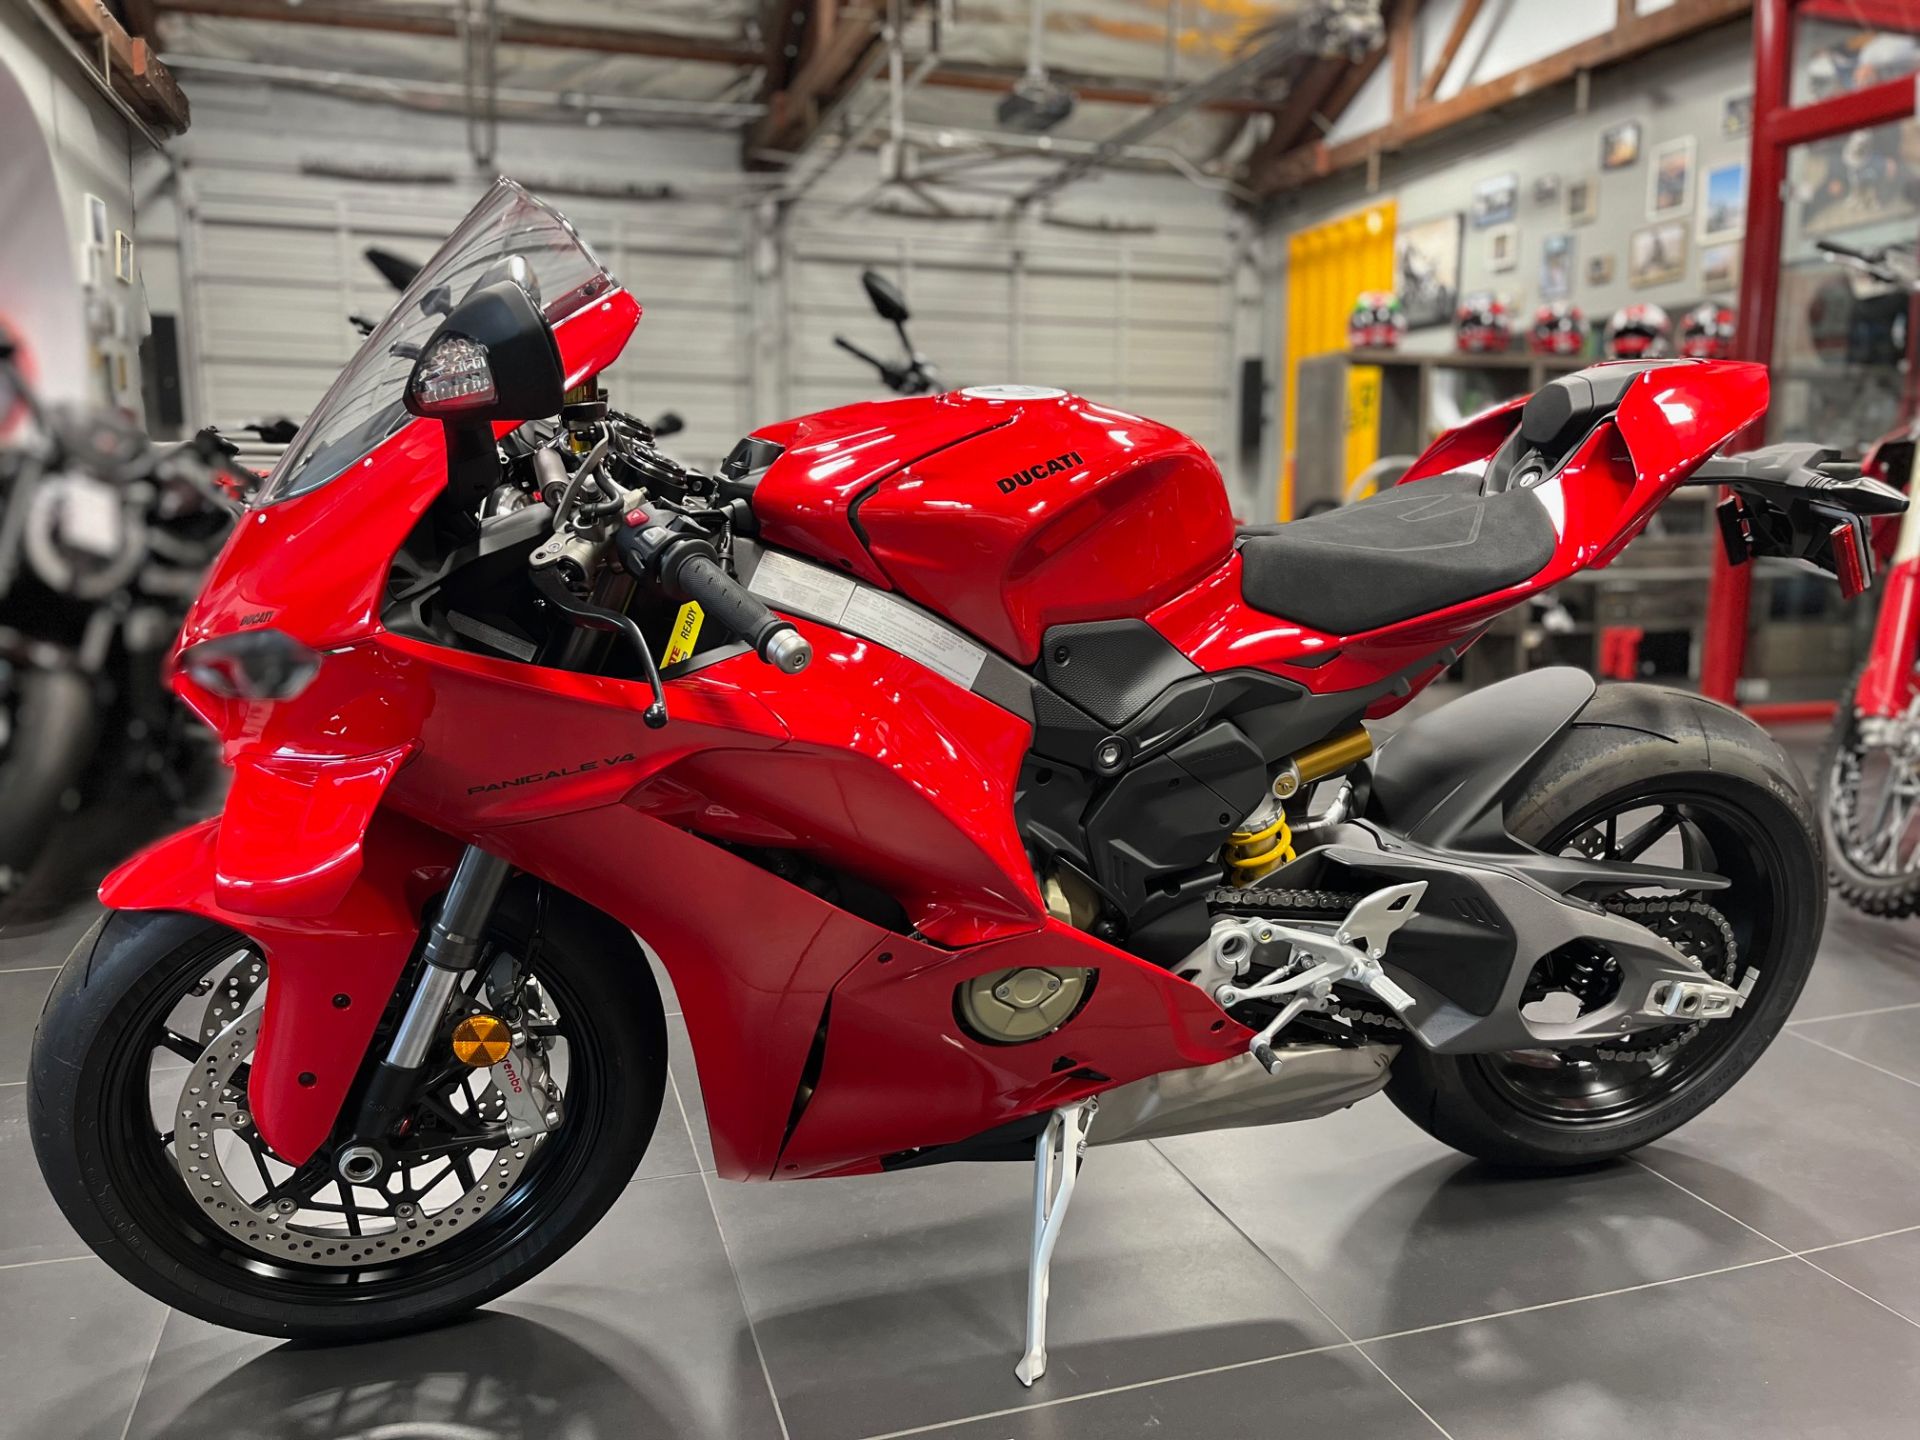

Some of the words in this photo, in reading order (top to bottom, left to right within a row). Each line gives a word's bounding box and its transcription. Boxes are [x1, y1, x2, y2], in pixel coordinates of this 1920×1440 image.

[996, 451, 1084, 495] DUCATI
[239, 610, 275, 627] DUCATI
[680, 607, 697, 640] READY
[467, 761, 599, 796] PANIGALE
[603, 752, 636, 766] V4
[501, 1058, 523, 1094] rembo
